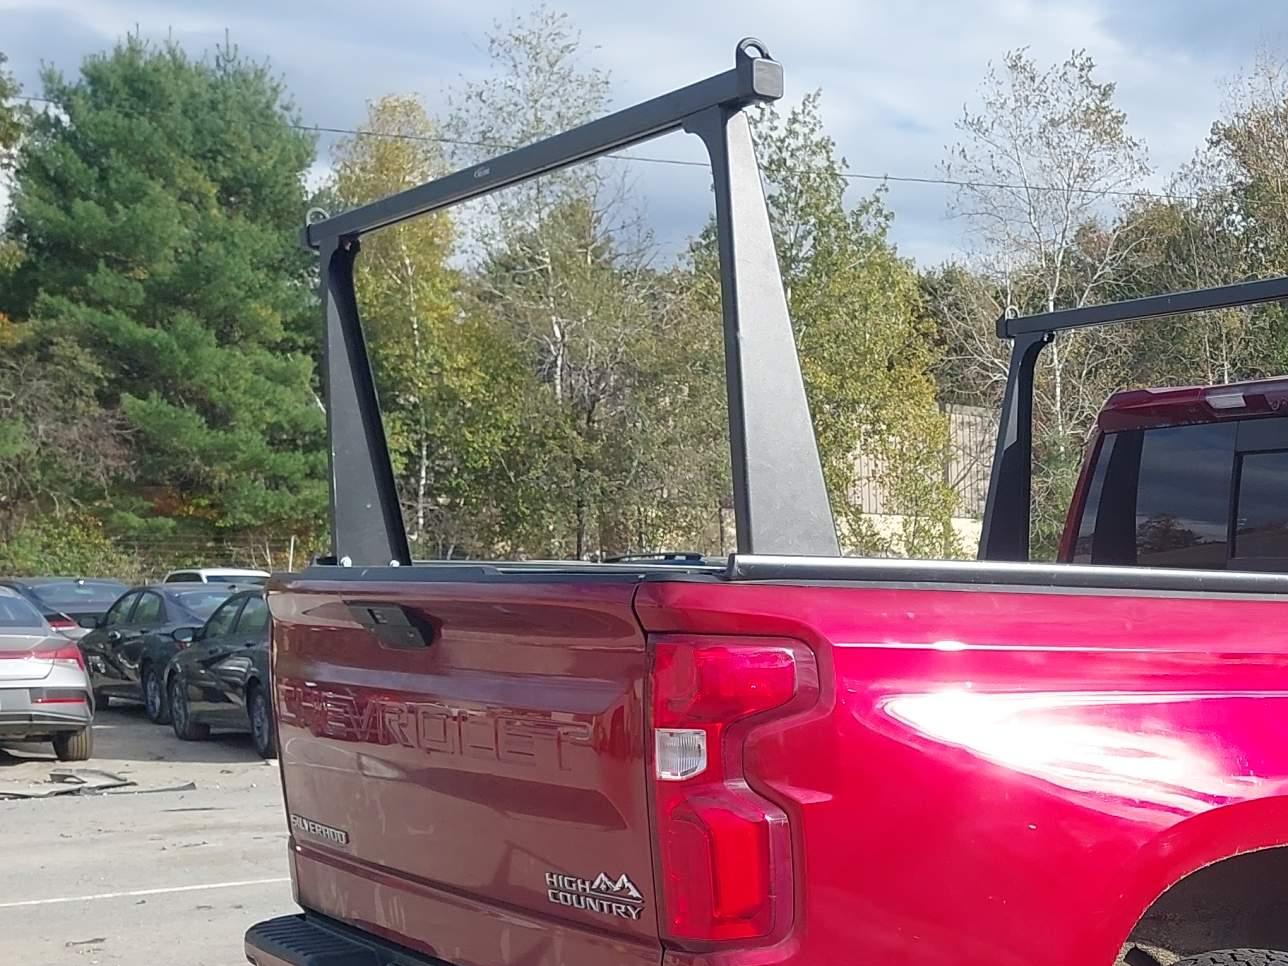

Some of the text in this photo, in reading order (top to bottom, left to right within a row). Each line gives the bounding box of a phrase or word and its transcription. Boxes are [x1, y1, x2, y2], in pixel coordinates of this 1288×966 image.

[278, 680, 594, 773] CHEVROLET
[290, 814, 347, 845] SILVERADO
[545, 872, 590, 893] HIGH
[547, 889, 641, 920] COUNTRY
